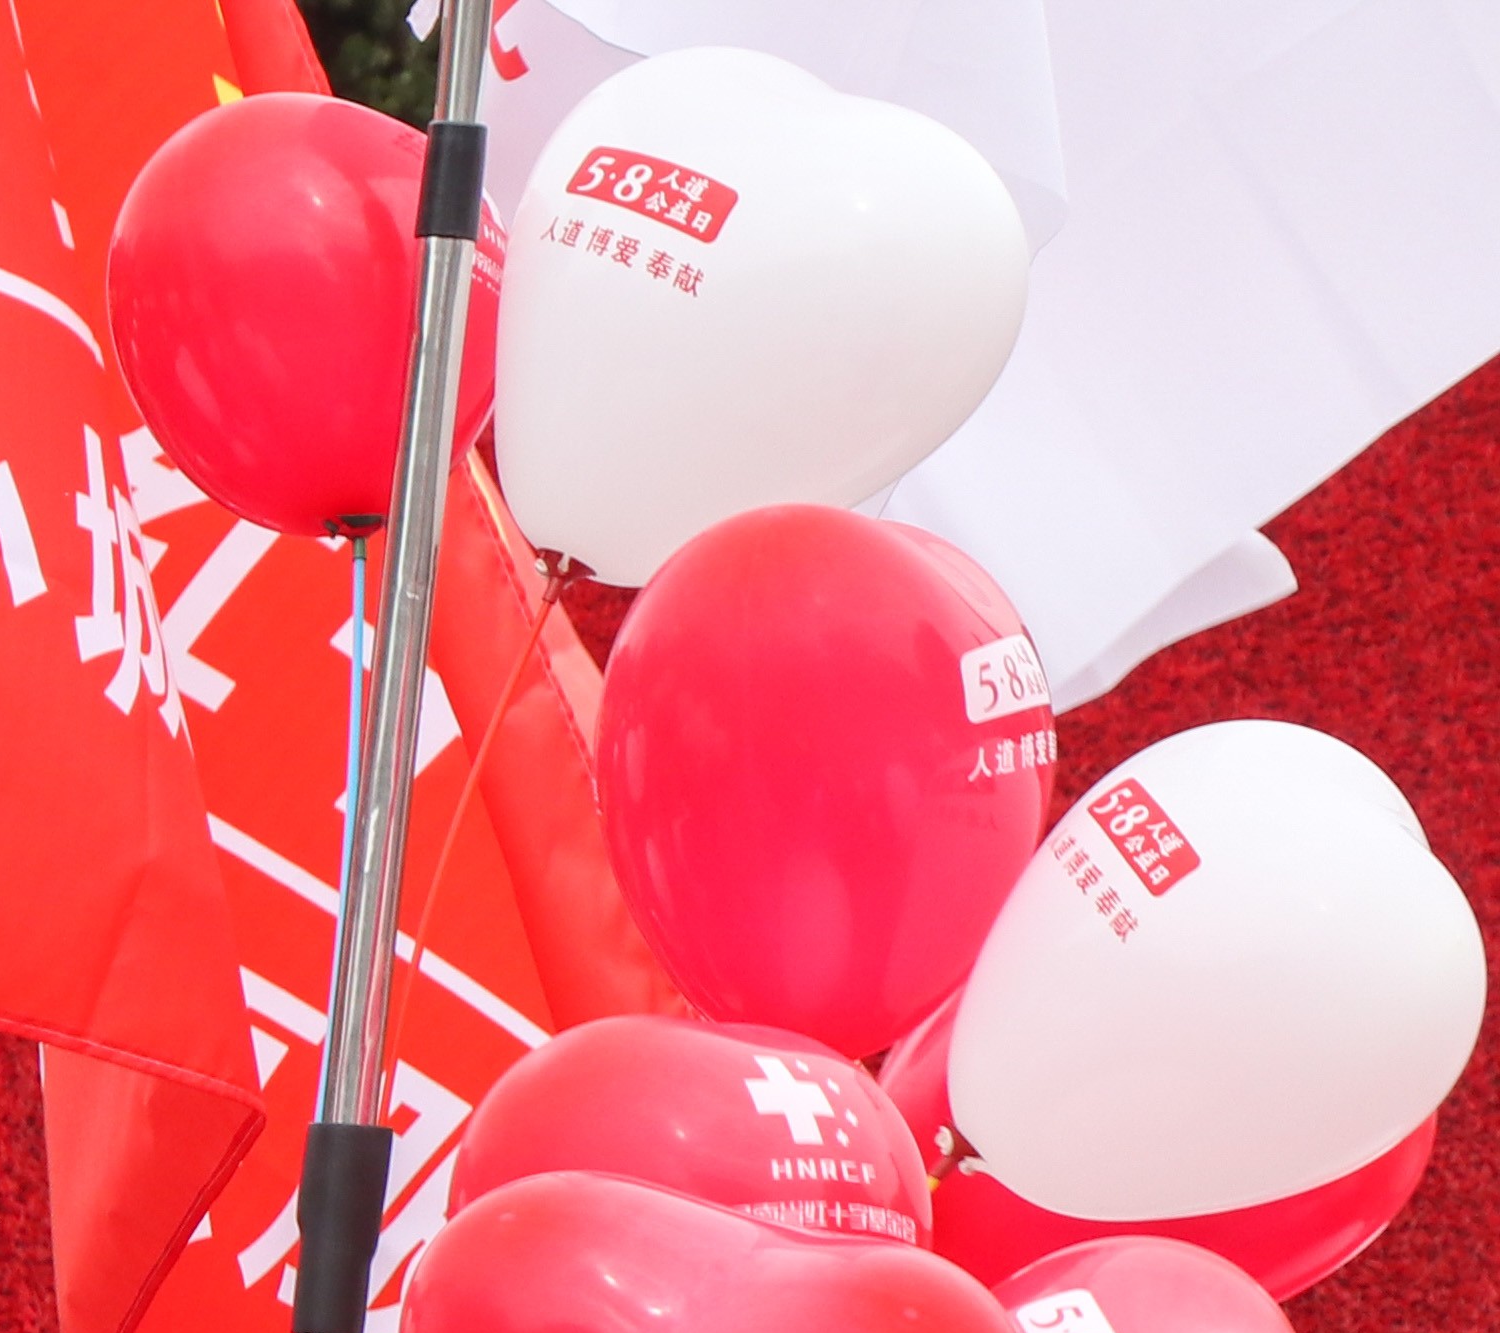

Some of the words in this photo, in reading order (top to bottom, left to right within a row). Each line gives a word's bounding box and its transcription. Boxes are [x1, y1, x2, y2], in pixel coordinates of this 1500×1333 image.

[658, 169, 709, 202] 人道
[645, 191, 713, 233] 公益日
[540, 216, 585, 248] 人道
[586, 226, 641, 268] 博爱
[646, 249, 705, 298] 奉献
[968, 738, 1015, 783] 人道
[771, 1158, 876, 1184] HNRCF
